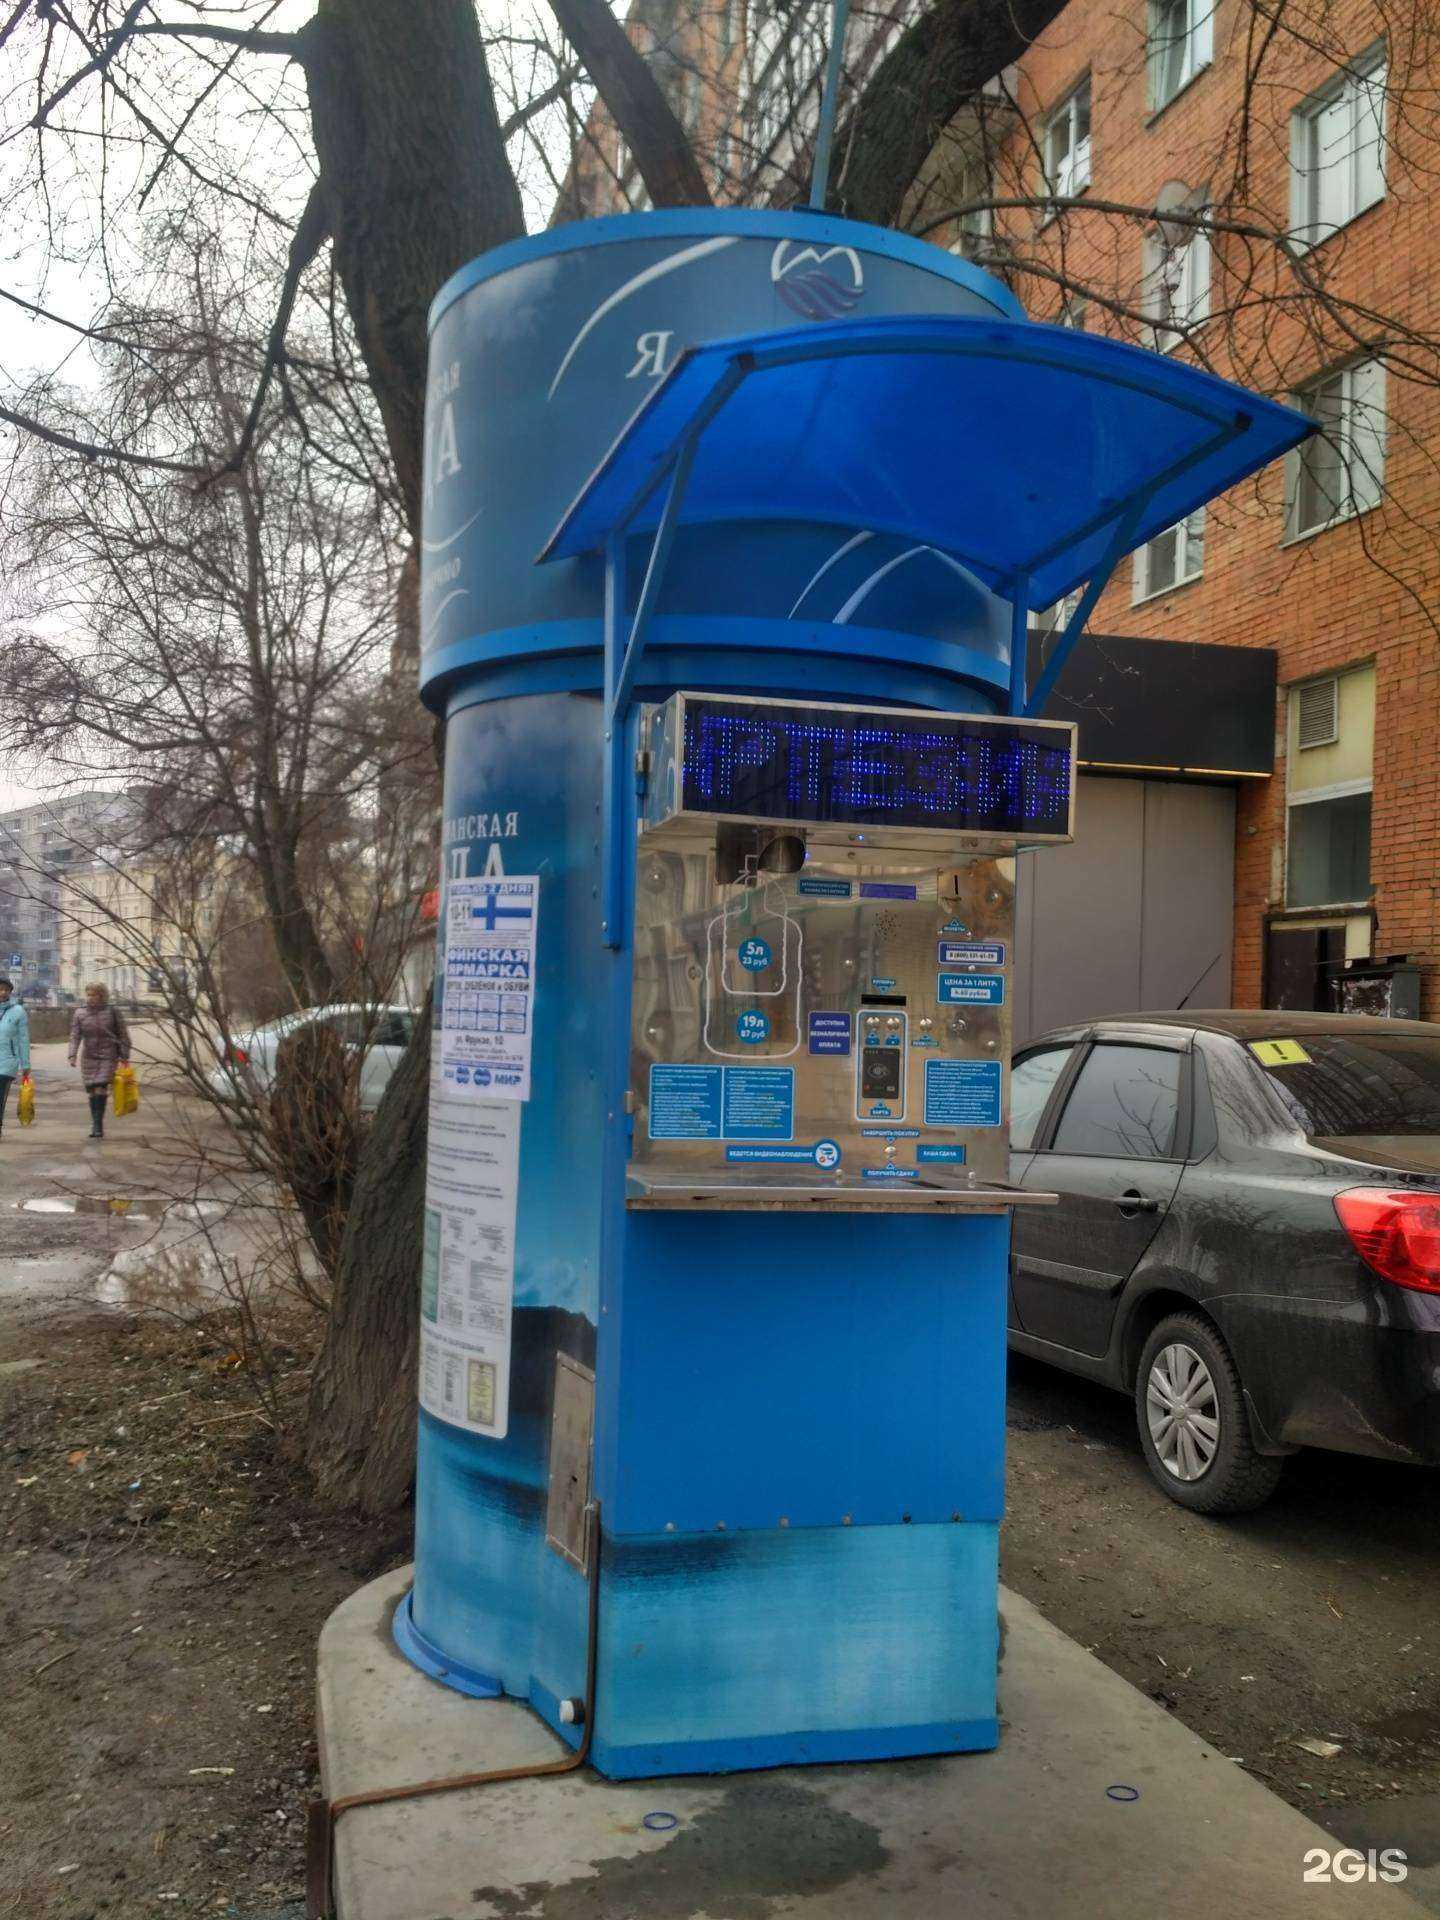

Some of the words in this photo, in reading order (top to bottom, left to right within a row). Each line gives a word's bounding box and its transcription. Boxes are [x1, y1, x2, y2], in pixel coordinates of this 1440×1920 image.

[746, 942, 764, 955] 5л
[448, 948, 529, 962] ФИНСКАЯ
[742, 956, 752, 964] 23
[753, 957, 768, 966] руб
[447, 962, 527, 977] ЯРМАРКА
[944, 978, 964, 987] ЦЕНА
[964, 979, 973, 987] ЗА
[742, 1015, 764, 1027] 19л
[751, 1030, 766, 1039] руб
[494, 1073, 522, 1086] МИР
